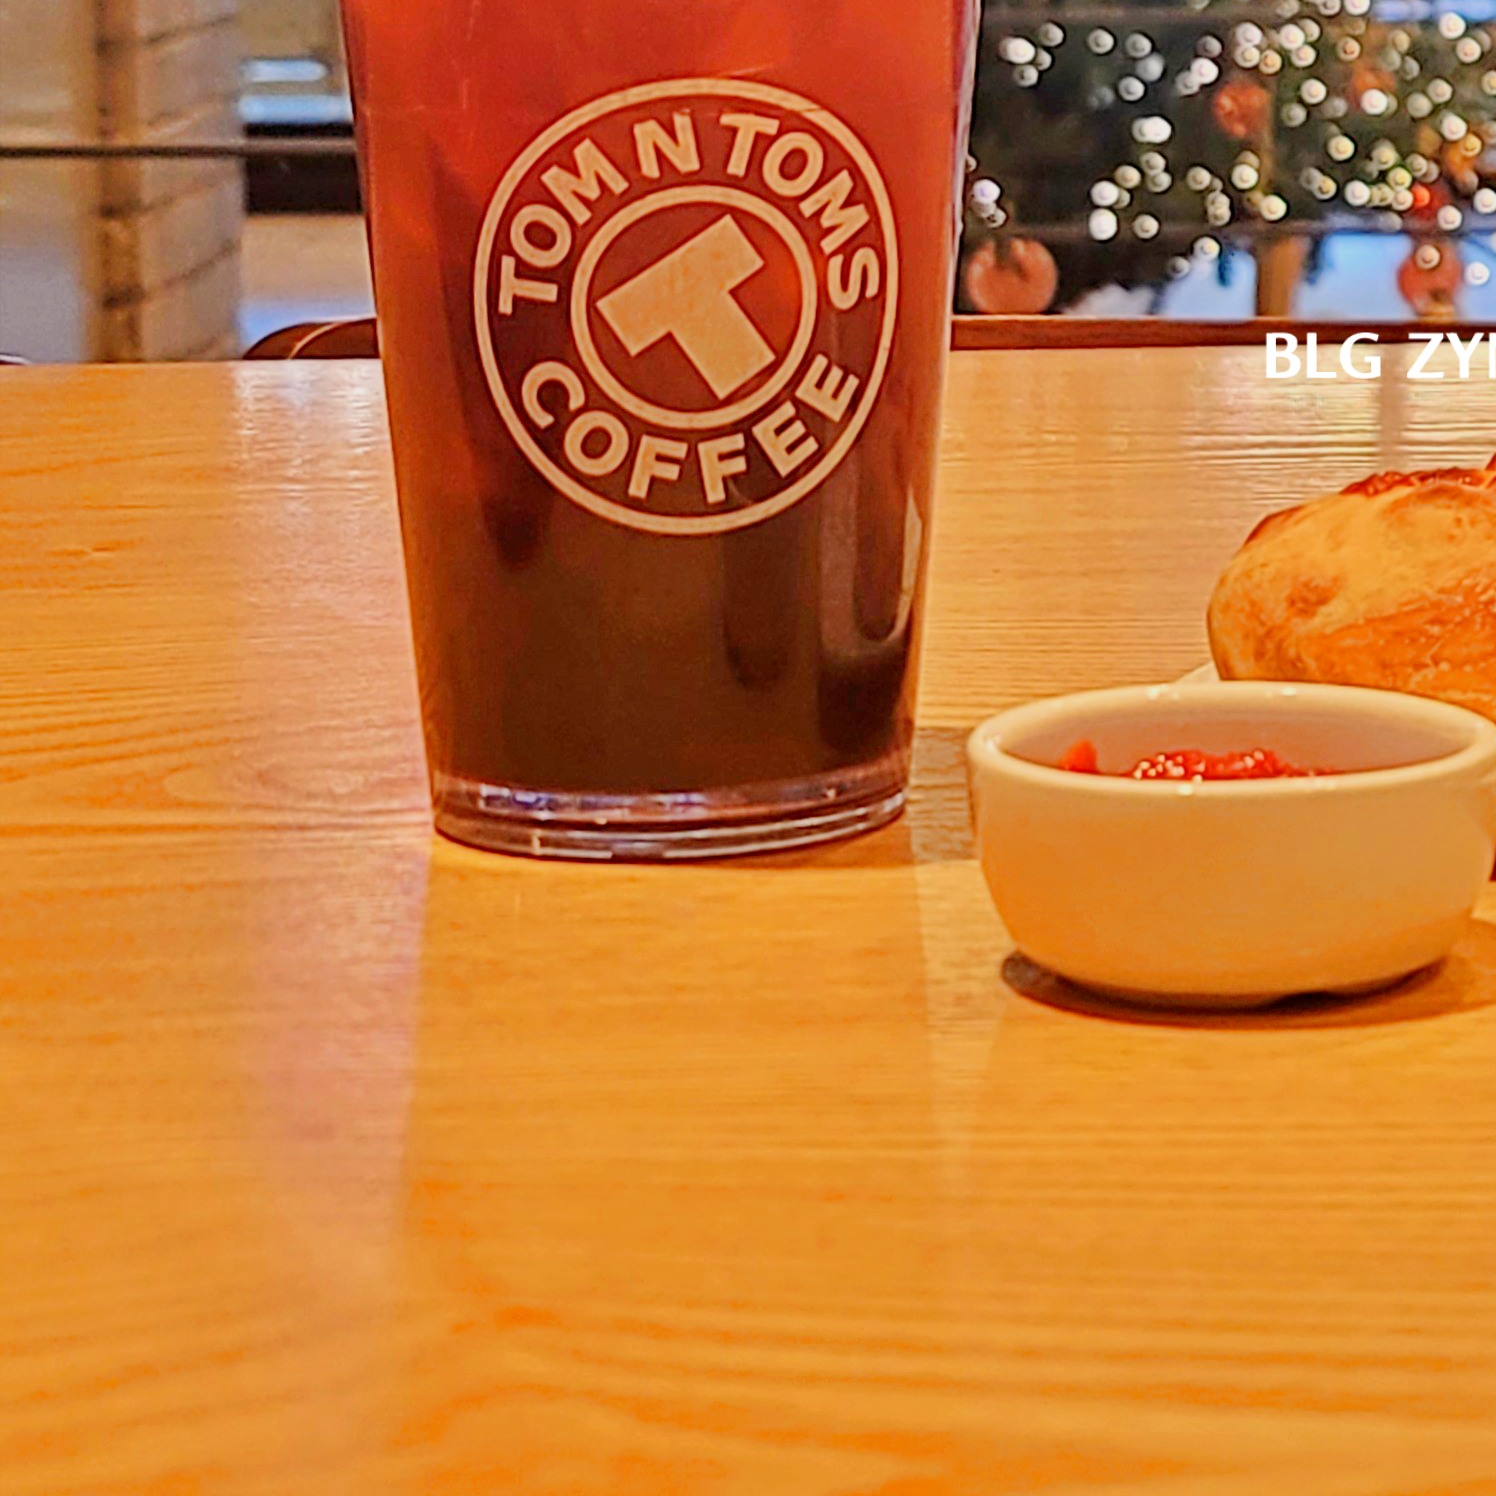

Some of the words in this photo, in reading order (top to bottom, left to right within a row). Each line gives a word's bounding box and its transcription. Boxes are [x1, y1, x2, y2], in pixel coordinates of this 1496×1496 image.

[498, 137, 630, 316] TOM
[633, 109, 701, 179] N
[719, 112, 880, 311] TOMS
[595, 213, 777, 401] T
[520, 353, 860, 505] COFFEE
